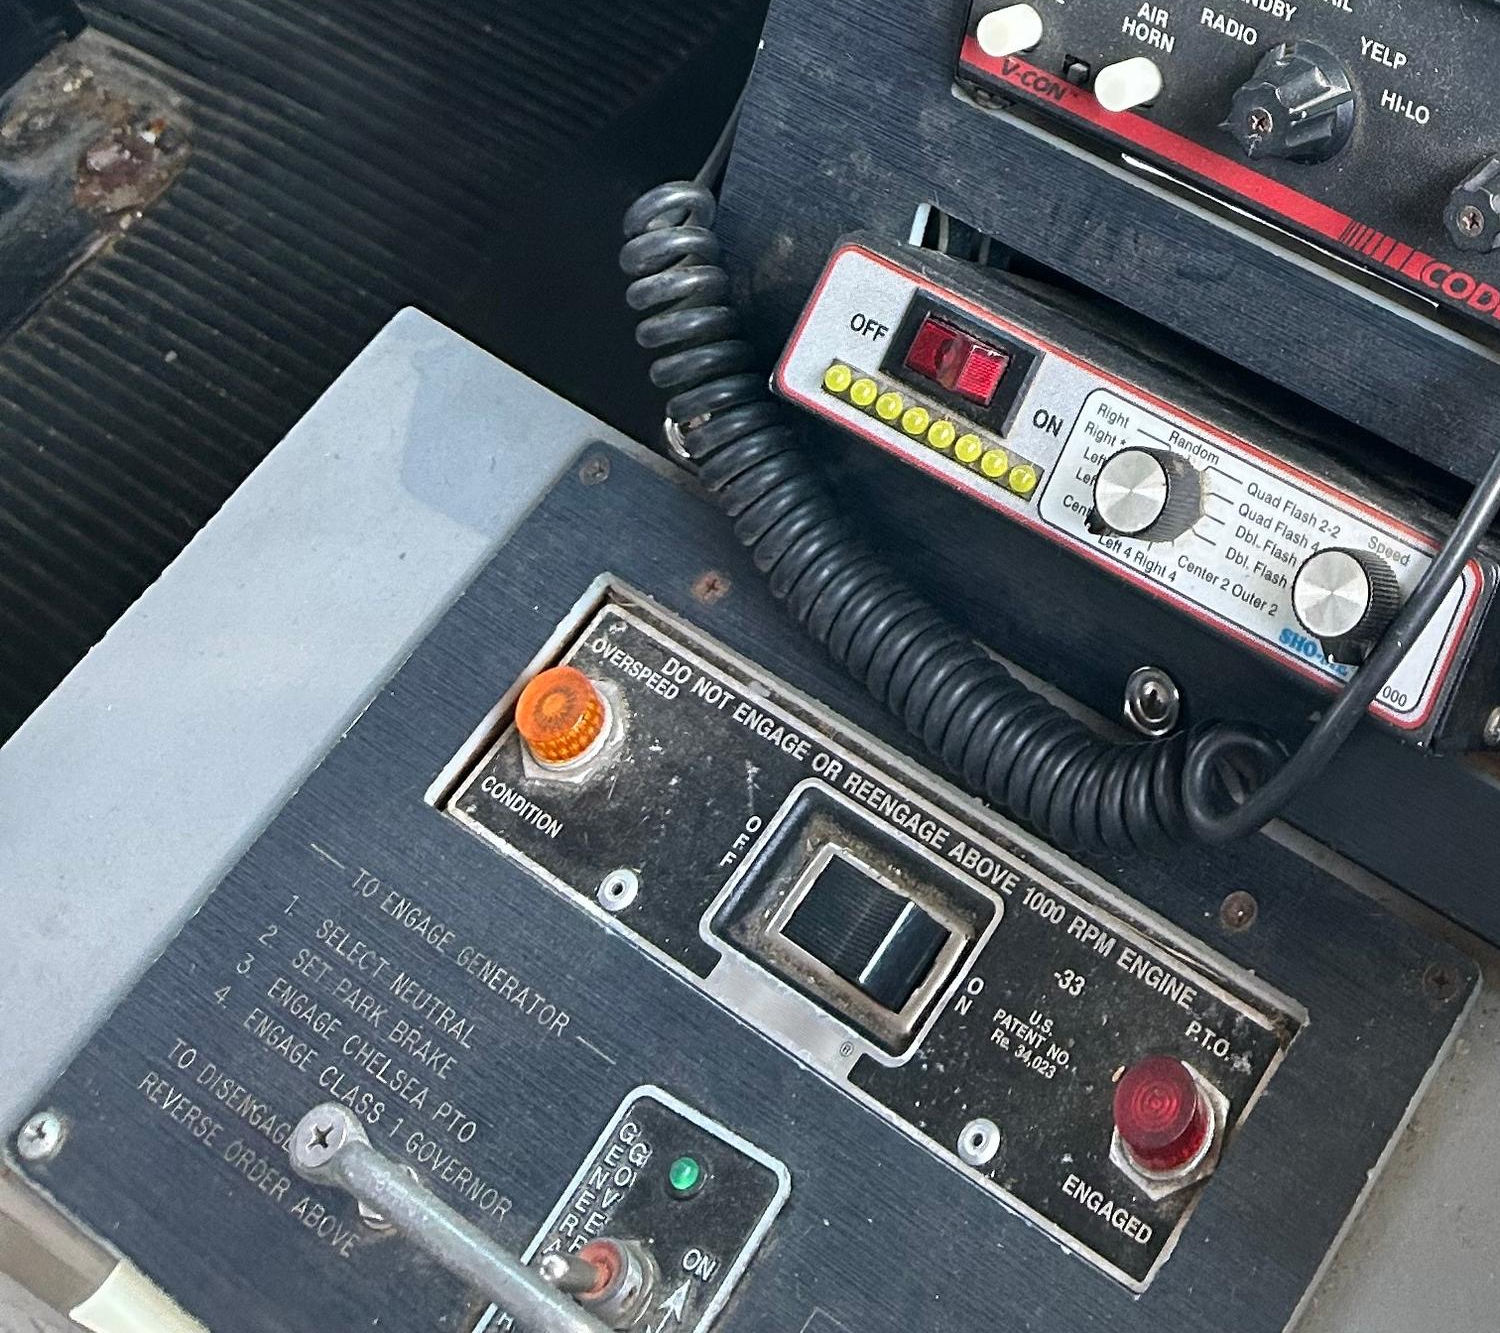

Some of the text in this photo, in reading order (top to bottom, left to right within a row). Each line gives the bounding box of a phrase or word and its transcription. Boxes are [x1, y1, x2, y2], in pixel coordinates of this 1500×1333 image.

[1121, 16, 1176, 53] HORN
[1137, 1, 1170, 28] AIR
[1200, 7, 1258, 46] RADIO
[1359, 36, 1408, 70] YELP
[1002, 58, 1068, 101] V-CON
[849, 313, 889, 342] OFF
[1031, 408, 1063, 437] ON
[1083, 421, 1117, 447] Right
[1097, 402, 1130, 429] Right
[1168, 430, 1220, 466] Random
[1075, 467, 1098, 487] Lef
[1063, 494, 1093, 517] Cent
[1246, 482, 1343, 540] Quad Flash 2-2
[1235, 525, 1298, 567] Dbl. Flash
[1238, 503, 1320, 553] Quad Flash 4
[1098, 534, 1177, 582] Left 4 Right 4
[1225, 546, 1288, 589] Dbl. Flash
[1366, 535, 1412, 568] Speed
[1177, 554, 1279, 616] Center 2 Outer 2
[591, 636, 680, 701] OVERSPEED
[481, 775, 564, 839] CONDITION
[660, 655, 1199, 1011] DO NOT ENGAGE OR REENGAGE ABOVE 1000 RPM ENGINE
[719, 815, 763, 868] OFF
[283, 894, 474, 1049] 1. SELECT NEUTRAL
[352, 868, 572, 1036] TO ENGAGE GENERATOR
[258, 924, 459, 1080] 2. SET PARK BRAKE
[954, 977, 985, 1016] ON
[1053, 968, 1087, 997] -33
[992, 1008, 1072, 1070] PATENT NO.
[1028, 1009, 1054, 1037] U.S.
[1184, 1021, 1231, 1062] P.T.O.
[236, 953, 479, 1145] 3. ENGAGE CHELSEA PTO
[1013, 1044, 1056, 1080] 34,023
[166, 1038, 296, 1153] TO DISENGAGE
[213, 984, 230, 1010] 4.
[243, 1008, 318, 1073] ENGAGE
[318, 1066, 386, 1124] CLASS
[391, 1117, 404, 1136] 1
[405, 1131, 514, 1219] GOVERNOR
[138, 1071, 224, 1147] REVERSE
[223, 1139, 291, 1204] ORDER
[290, 1197, 363, 1259] ABOVE
[1061, 1173, 1153, 1246] ENGAGED
[682, 1248, 717, 1282] ON
